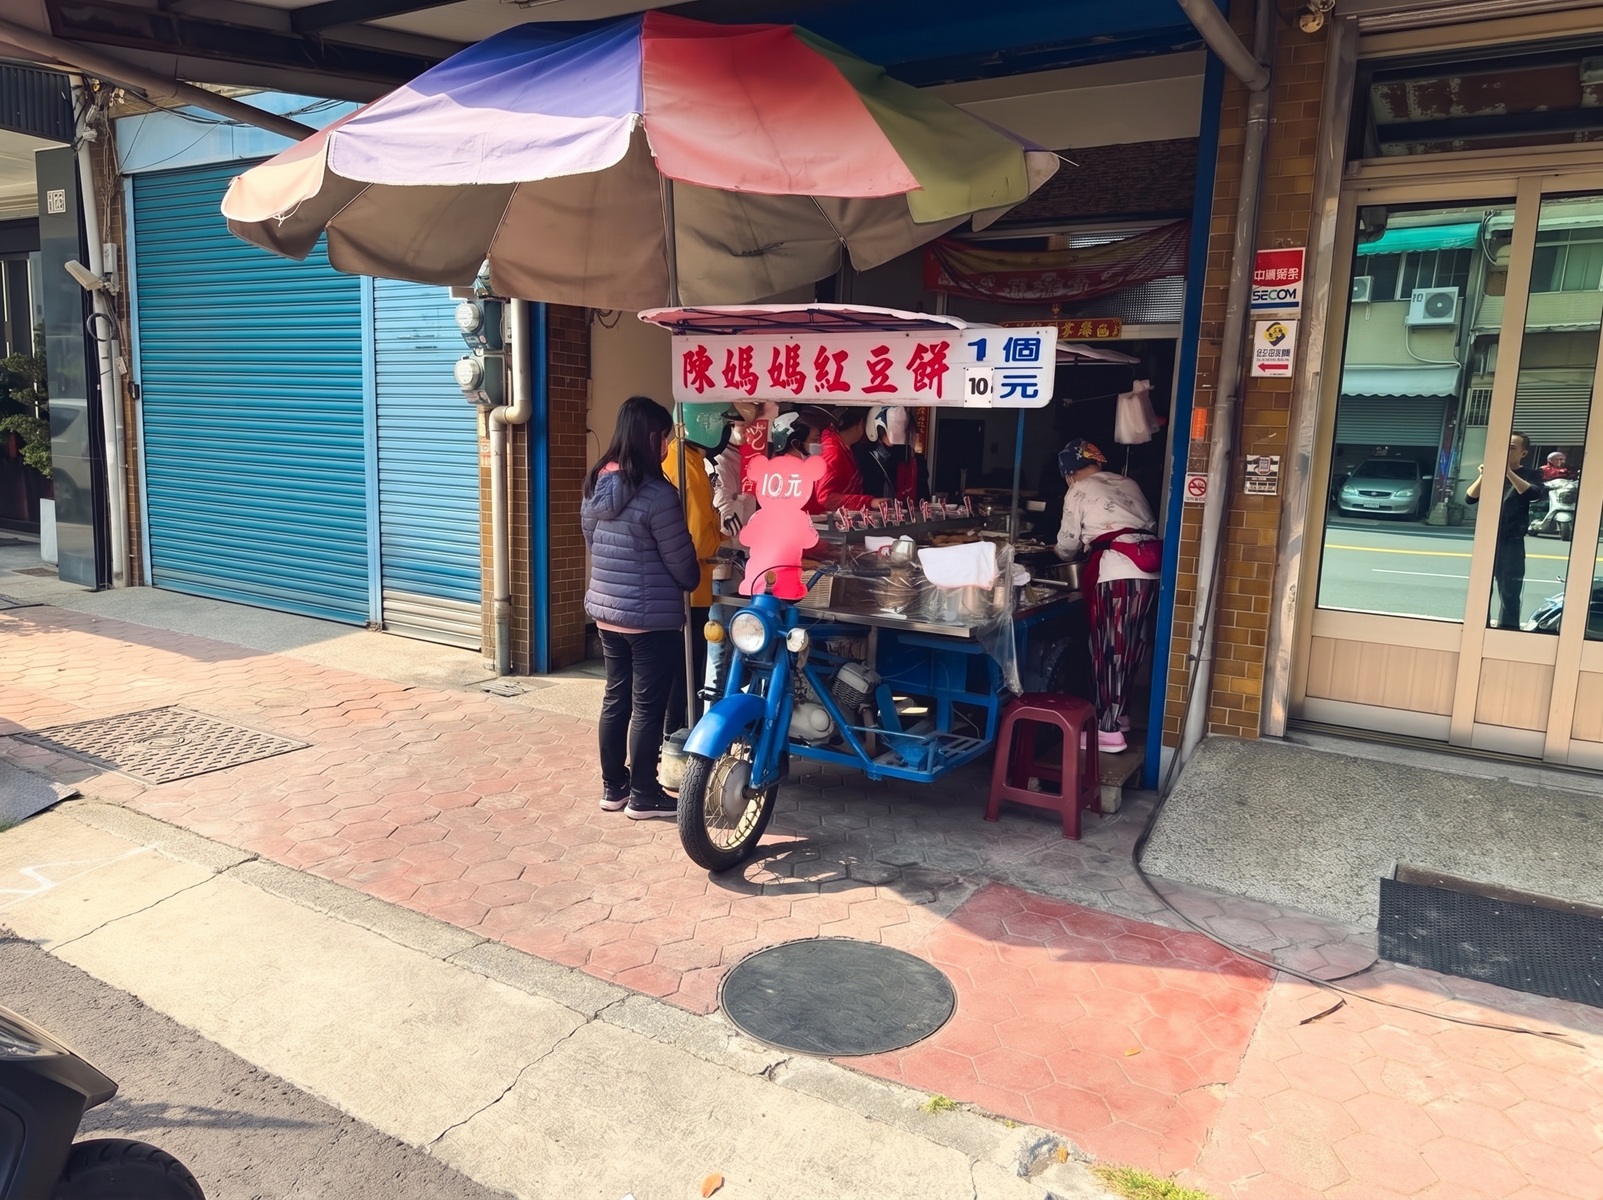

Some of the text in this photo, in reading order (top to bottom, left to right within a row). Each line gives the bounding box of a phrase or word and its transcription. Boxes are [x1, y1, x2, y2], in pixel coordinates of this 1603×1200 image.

[1252, 288, 1297, 301] SECOM
[682, 341, 951, 399] 陳媽媽紅豆餅
